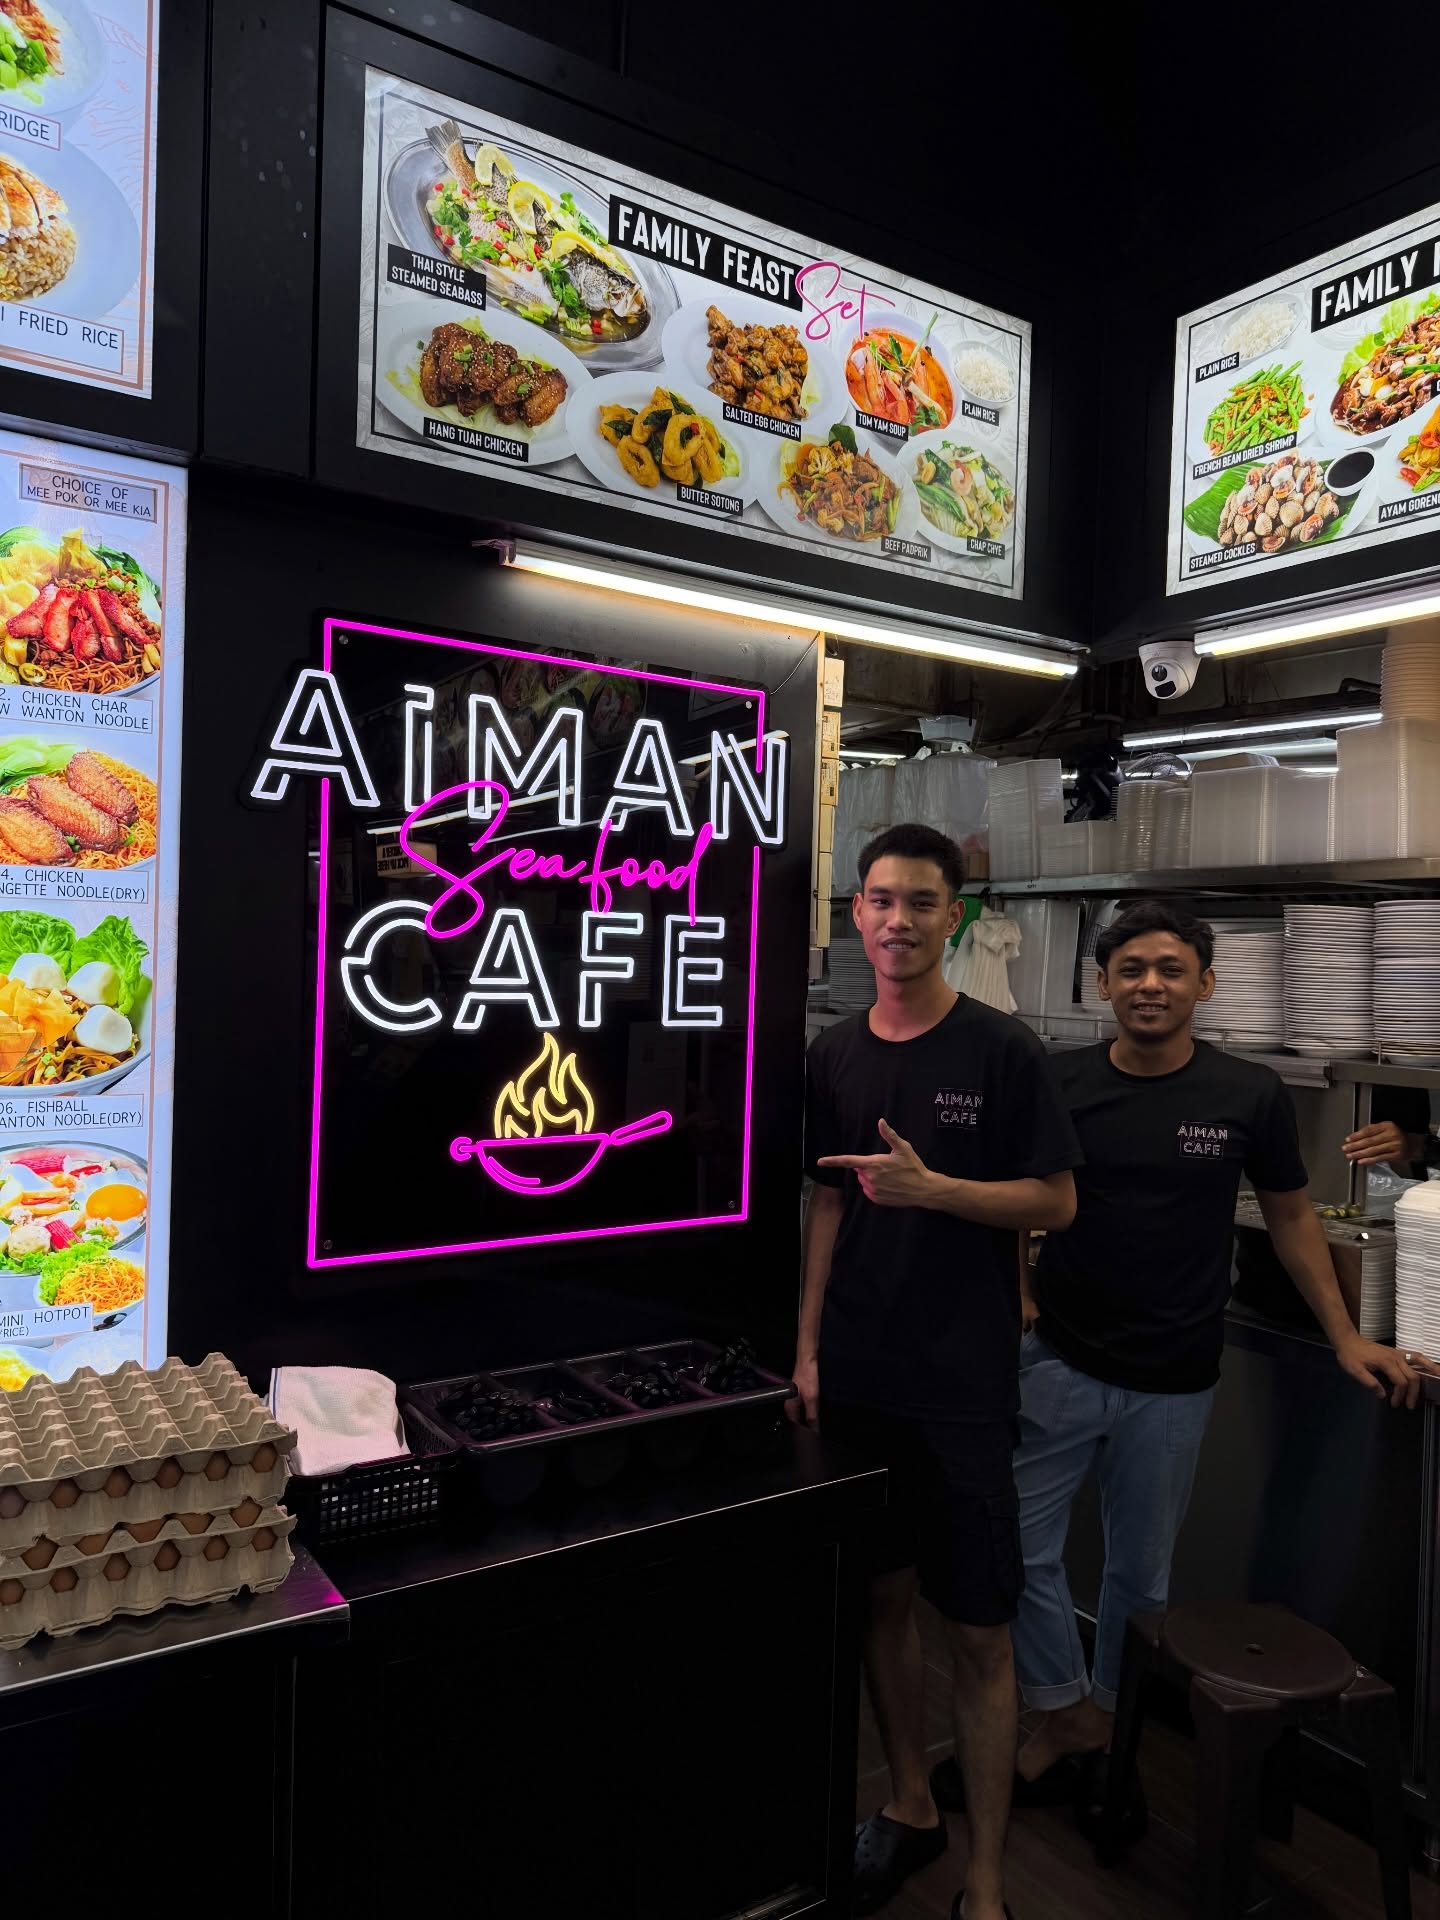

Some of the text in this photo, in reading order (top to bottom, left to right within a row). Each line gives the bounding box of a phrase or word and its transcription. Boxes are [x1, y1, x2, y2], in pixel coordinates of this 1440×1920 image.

[411, 253, 465, 283] THAI STYLE
[618, 203, 897, 341] FAMILY FEAST Set
[391, 265, 483, 306] STEAMED SEABASS
[1319, 250, 1419, 323] FAMILY
[19, 310, 68, 336] FRIED
[82, 326, 118, 350] RICE
[1199, 354, 1237, 379] PLAIN RICE
[725, 405, 800, 438] SALTED EGG CHICKEN
[858, 413, 906, 437] TOM YAM SOUP
[964, 403, 996, 422] PLAIN RICE
[429, 421, 523, 458] HANG TUAH CHICKEN
[1194, 435, 1295, 477] FRENCH BEAN DRIED SHRIMP
[52, 475, 129, 500] CHOICE OF
[681, 486, 740, 513] BUTTER SOTONG
[27, 485, 151, 517] MEE POK OR MEE KIA
[1380, 501, 1407, 520] AYAM
[884, 538, 900, 552] BEEF
[970, 538, 1003, 557] CHAP CHYE
[1190, 542, 1256, 569] STEAMED COCKLES
[22, 690, 81, 709] CHICKEN
[91, 698, 128, 714] CHAR
[21, 705, 84, 723] WANTON
[94, 712, 149, 730] NOODLE
[250, 667, 787, 845] AIMAN
[400, 780, 713, 939] Seafood
[25, 868, 84, 884] CHICKEN
[57, 885, 146, 902] NOODLE(DRY)
[340, 898, 726, 1032] CAFE
[27, 1099, 88, 1114] FISHBALL
[934, 1092, 983, 1108] AIMAN
[54, 1111, 142, 1127] NOODLE(DRY)
[940, 1110, 977, 1125] CAFE
[1177, 1125, 1228, 1140] AIMAN
[1183, 1141, 1221, 1156] CAFE
[34, 1306, 90, 1324] HOTPOT
